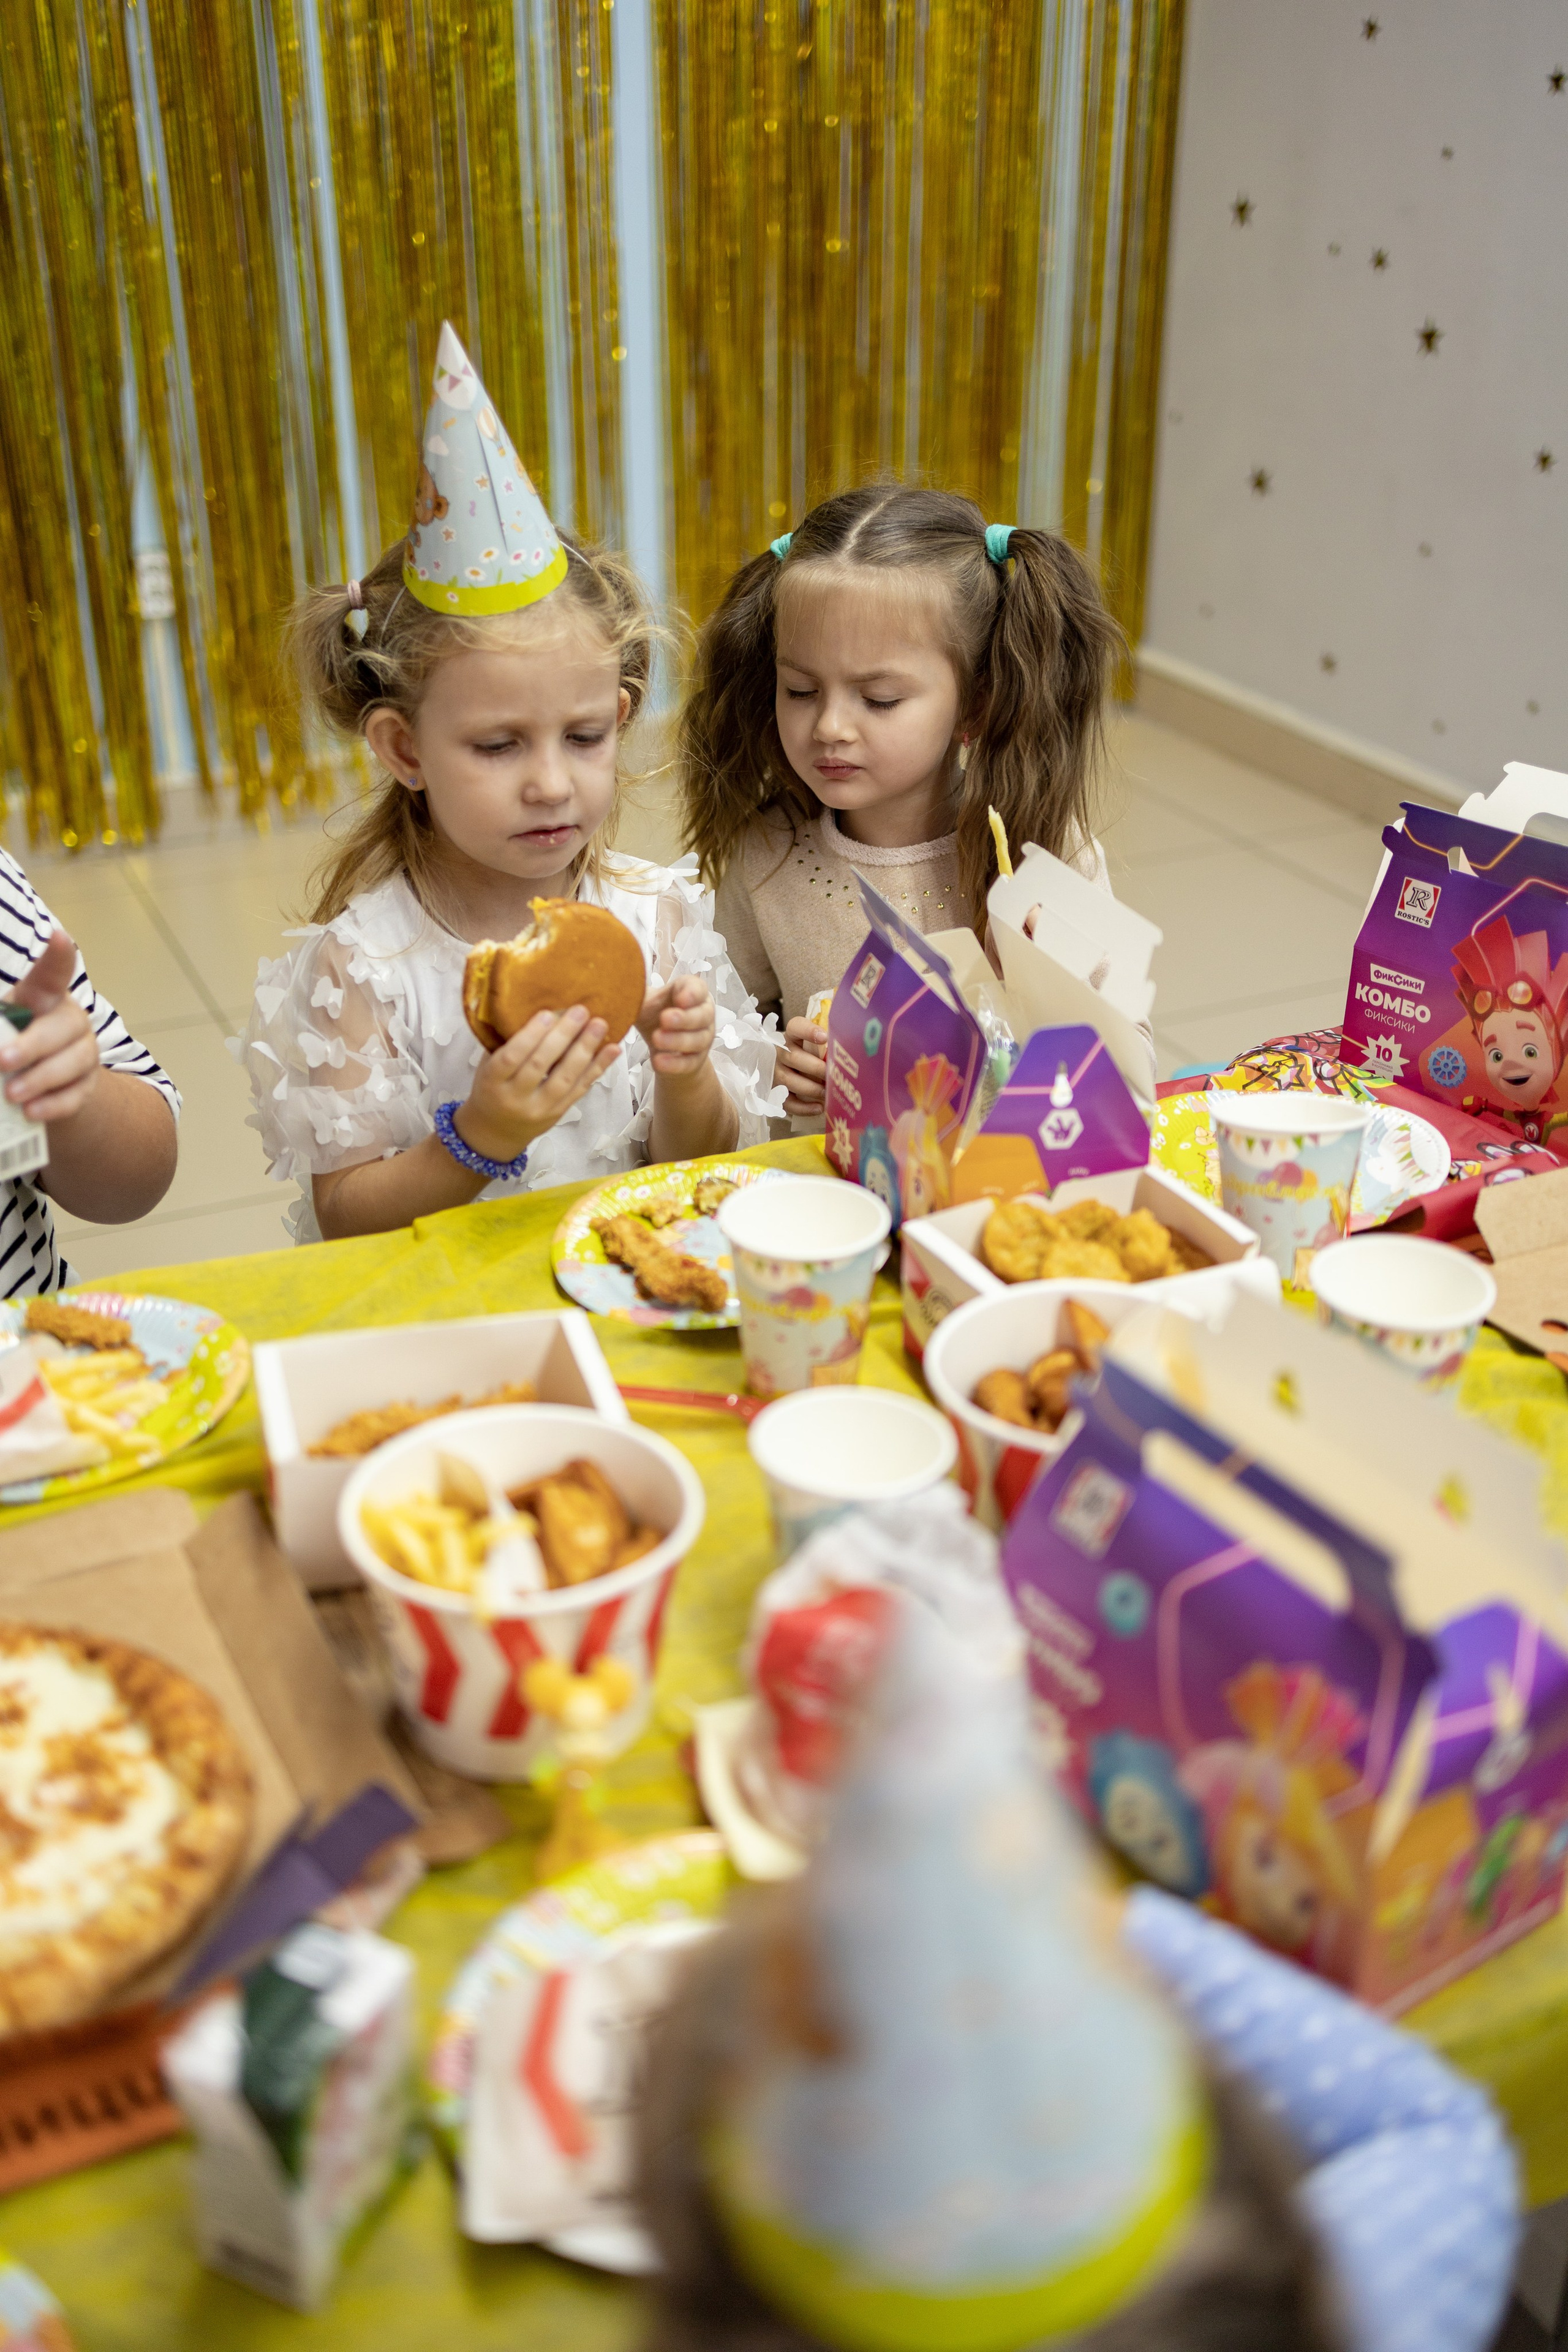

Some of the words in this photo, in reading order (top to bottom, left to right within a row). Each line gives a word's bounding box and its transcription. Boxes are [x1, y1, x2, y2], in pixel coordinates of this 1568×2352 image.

[1406, 887, 1431, 911] R
[1397, 911, 1430, 925] ROSTIC'S
[1355, 982, 1431, 1023] КОМБО
[1364, 1009, 1415, 1033] ФИКСИКИ
[1376, 1044, 1392, 1062] 10
